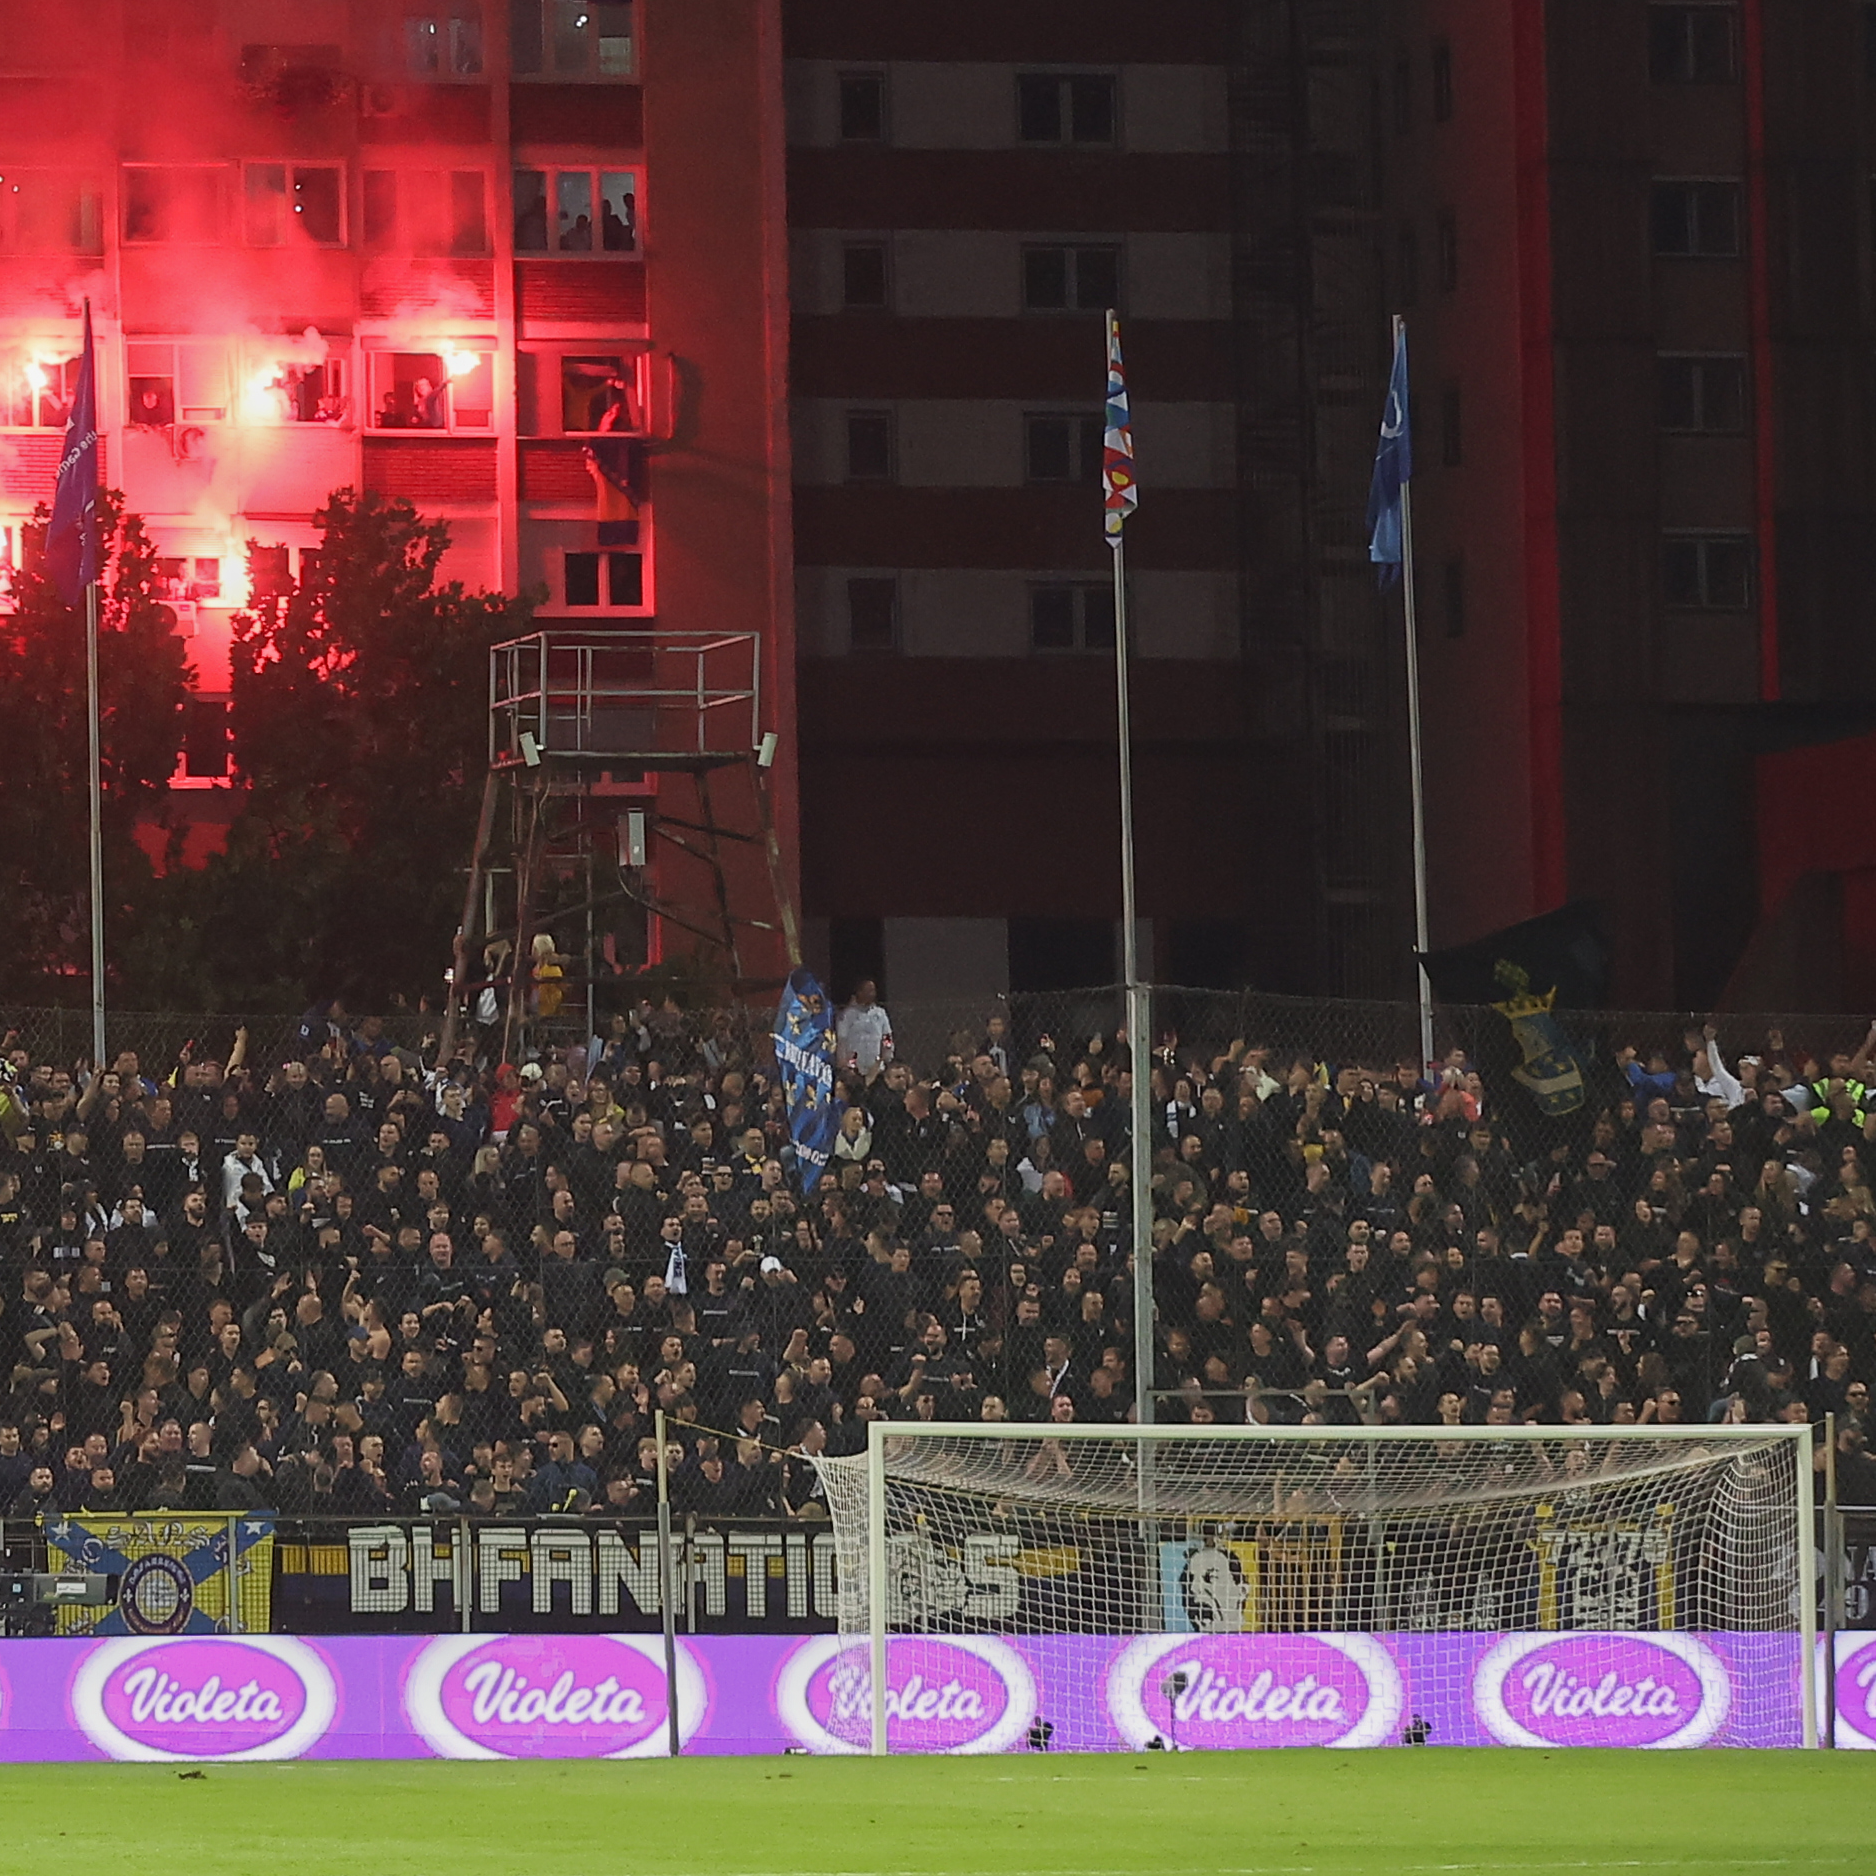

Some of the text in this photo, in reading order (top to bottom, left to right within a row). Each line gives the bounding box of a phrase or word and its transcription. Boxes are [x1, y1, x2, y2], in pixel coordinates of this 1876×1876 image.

[123, 1667, 284, 1724] Violeta
[464, 1660, 646, 1724] Violeta
[1173, 1659, 1343, 1723] Violeta
[1522, 1664, 1681, 1717] Violeta
